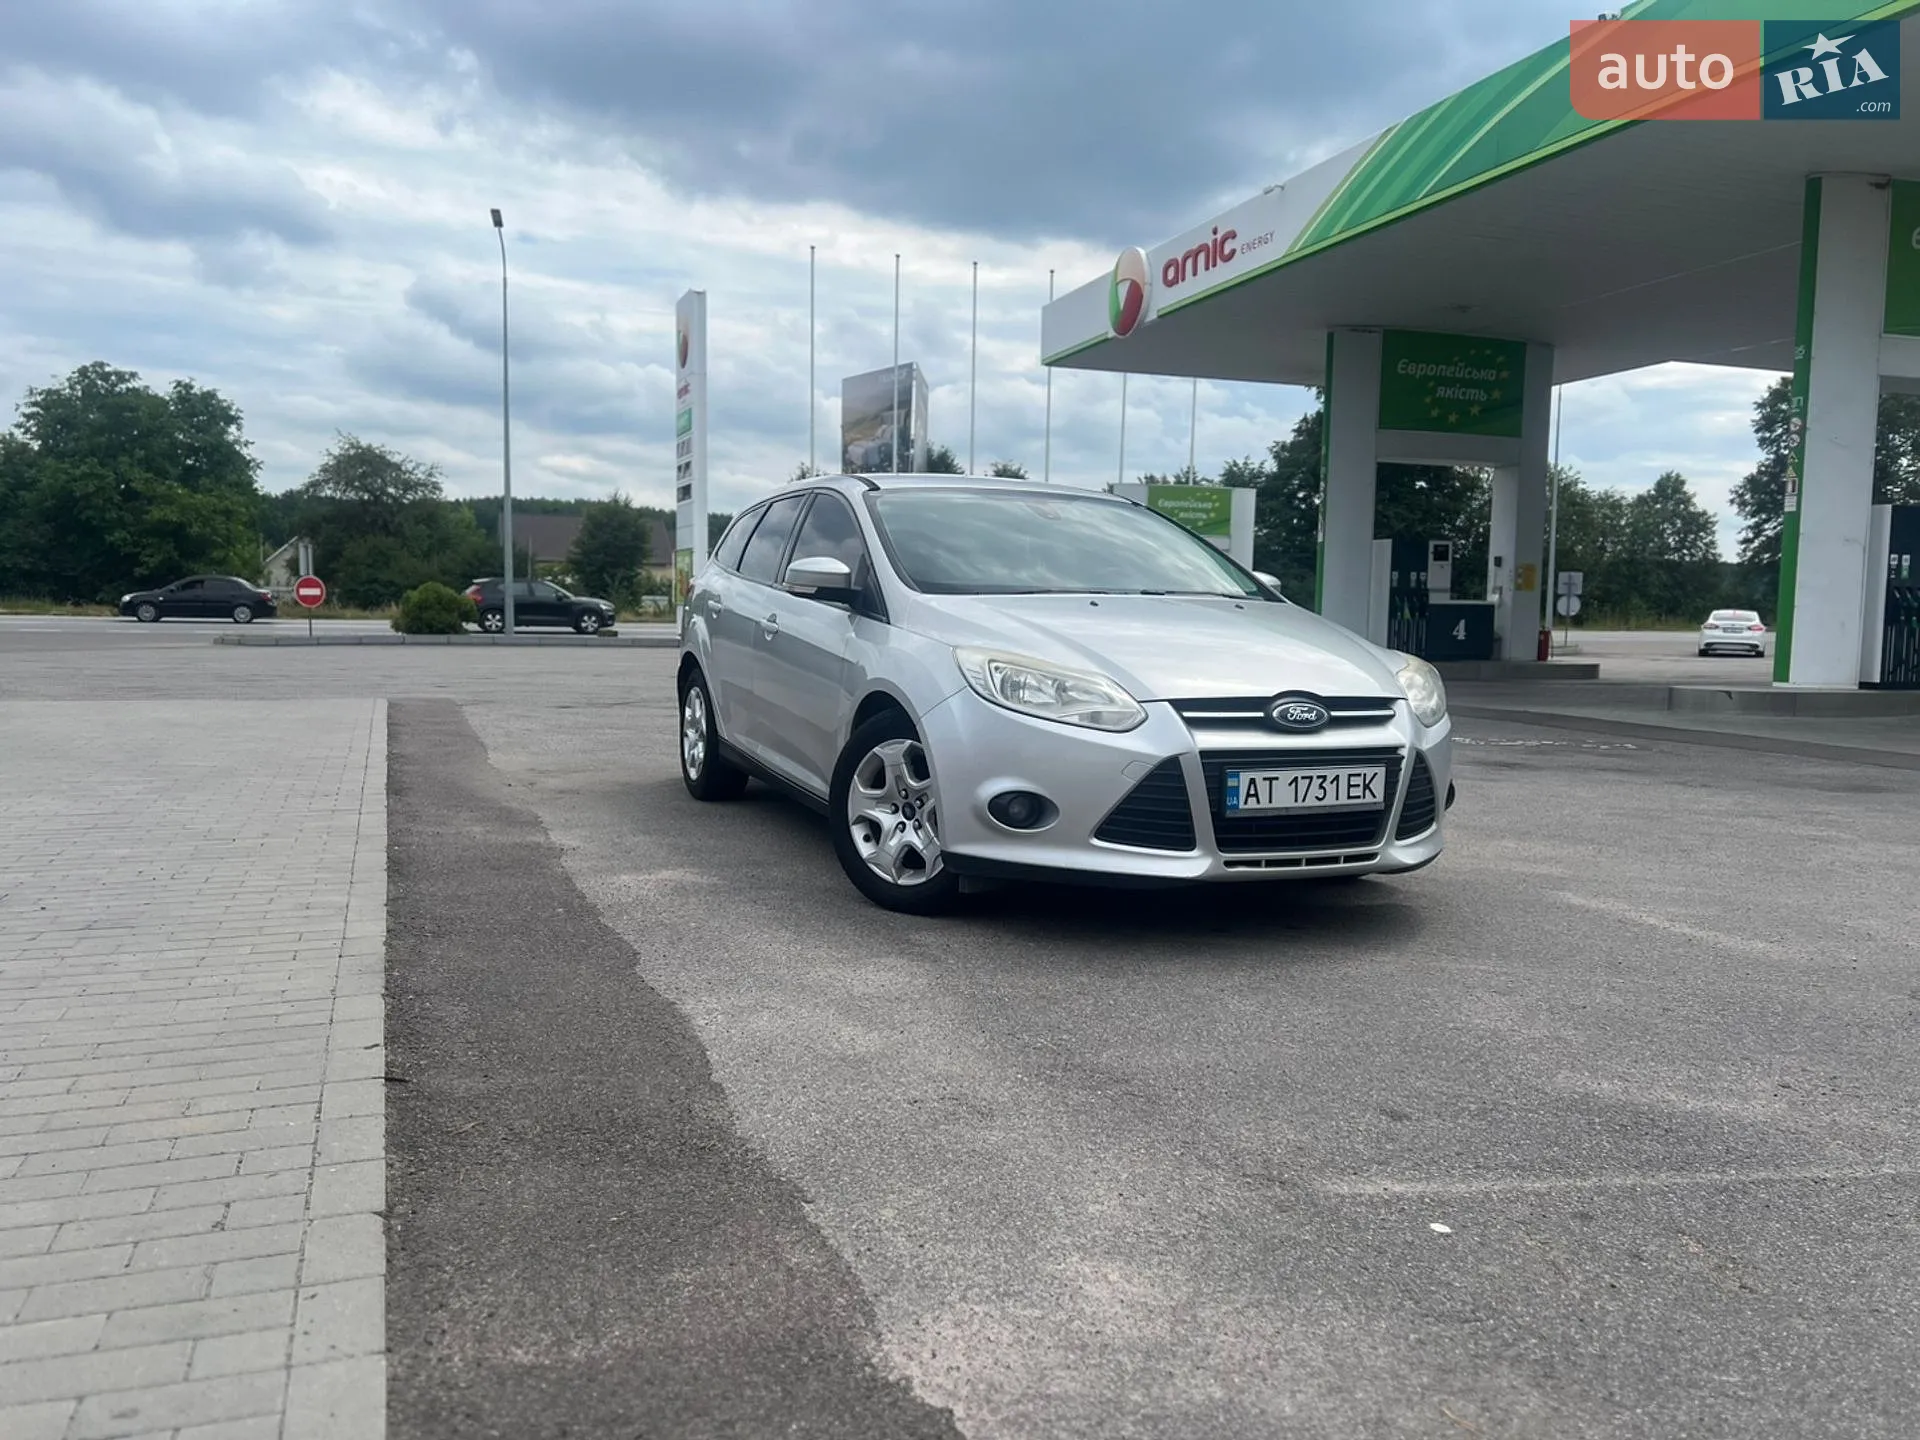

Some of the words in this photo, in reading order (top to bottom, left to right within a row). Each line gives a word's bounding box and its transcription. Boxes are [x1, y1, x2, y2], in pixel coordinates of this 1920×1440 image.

[1162, 226, 1237, 288] amic
[1240, 230, 1276, 255] ENERGY
[1396, 358, 1497, 381] Європейська
[1435, 383, 1488, 402] якість
[1452, 618, 1467, 640] 4
[1287, 706, 1318, 721] Ford
[1243, 777, 1279, 806] AT
[1288, 773, 1340, 803] 1731
[1347, 772, 1379, 801] EK
[1227, 796, 1238, 806] UA
